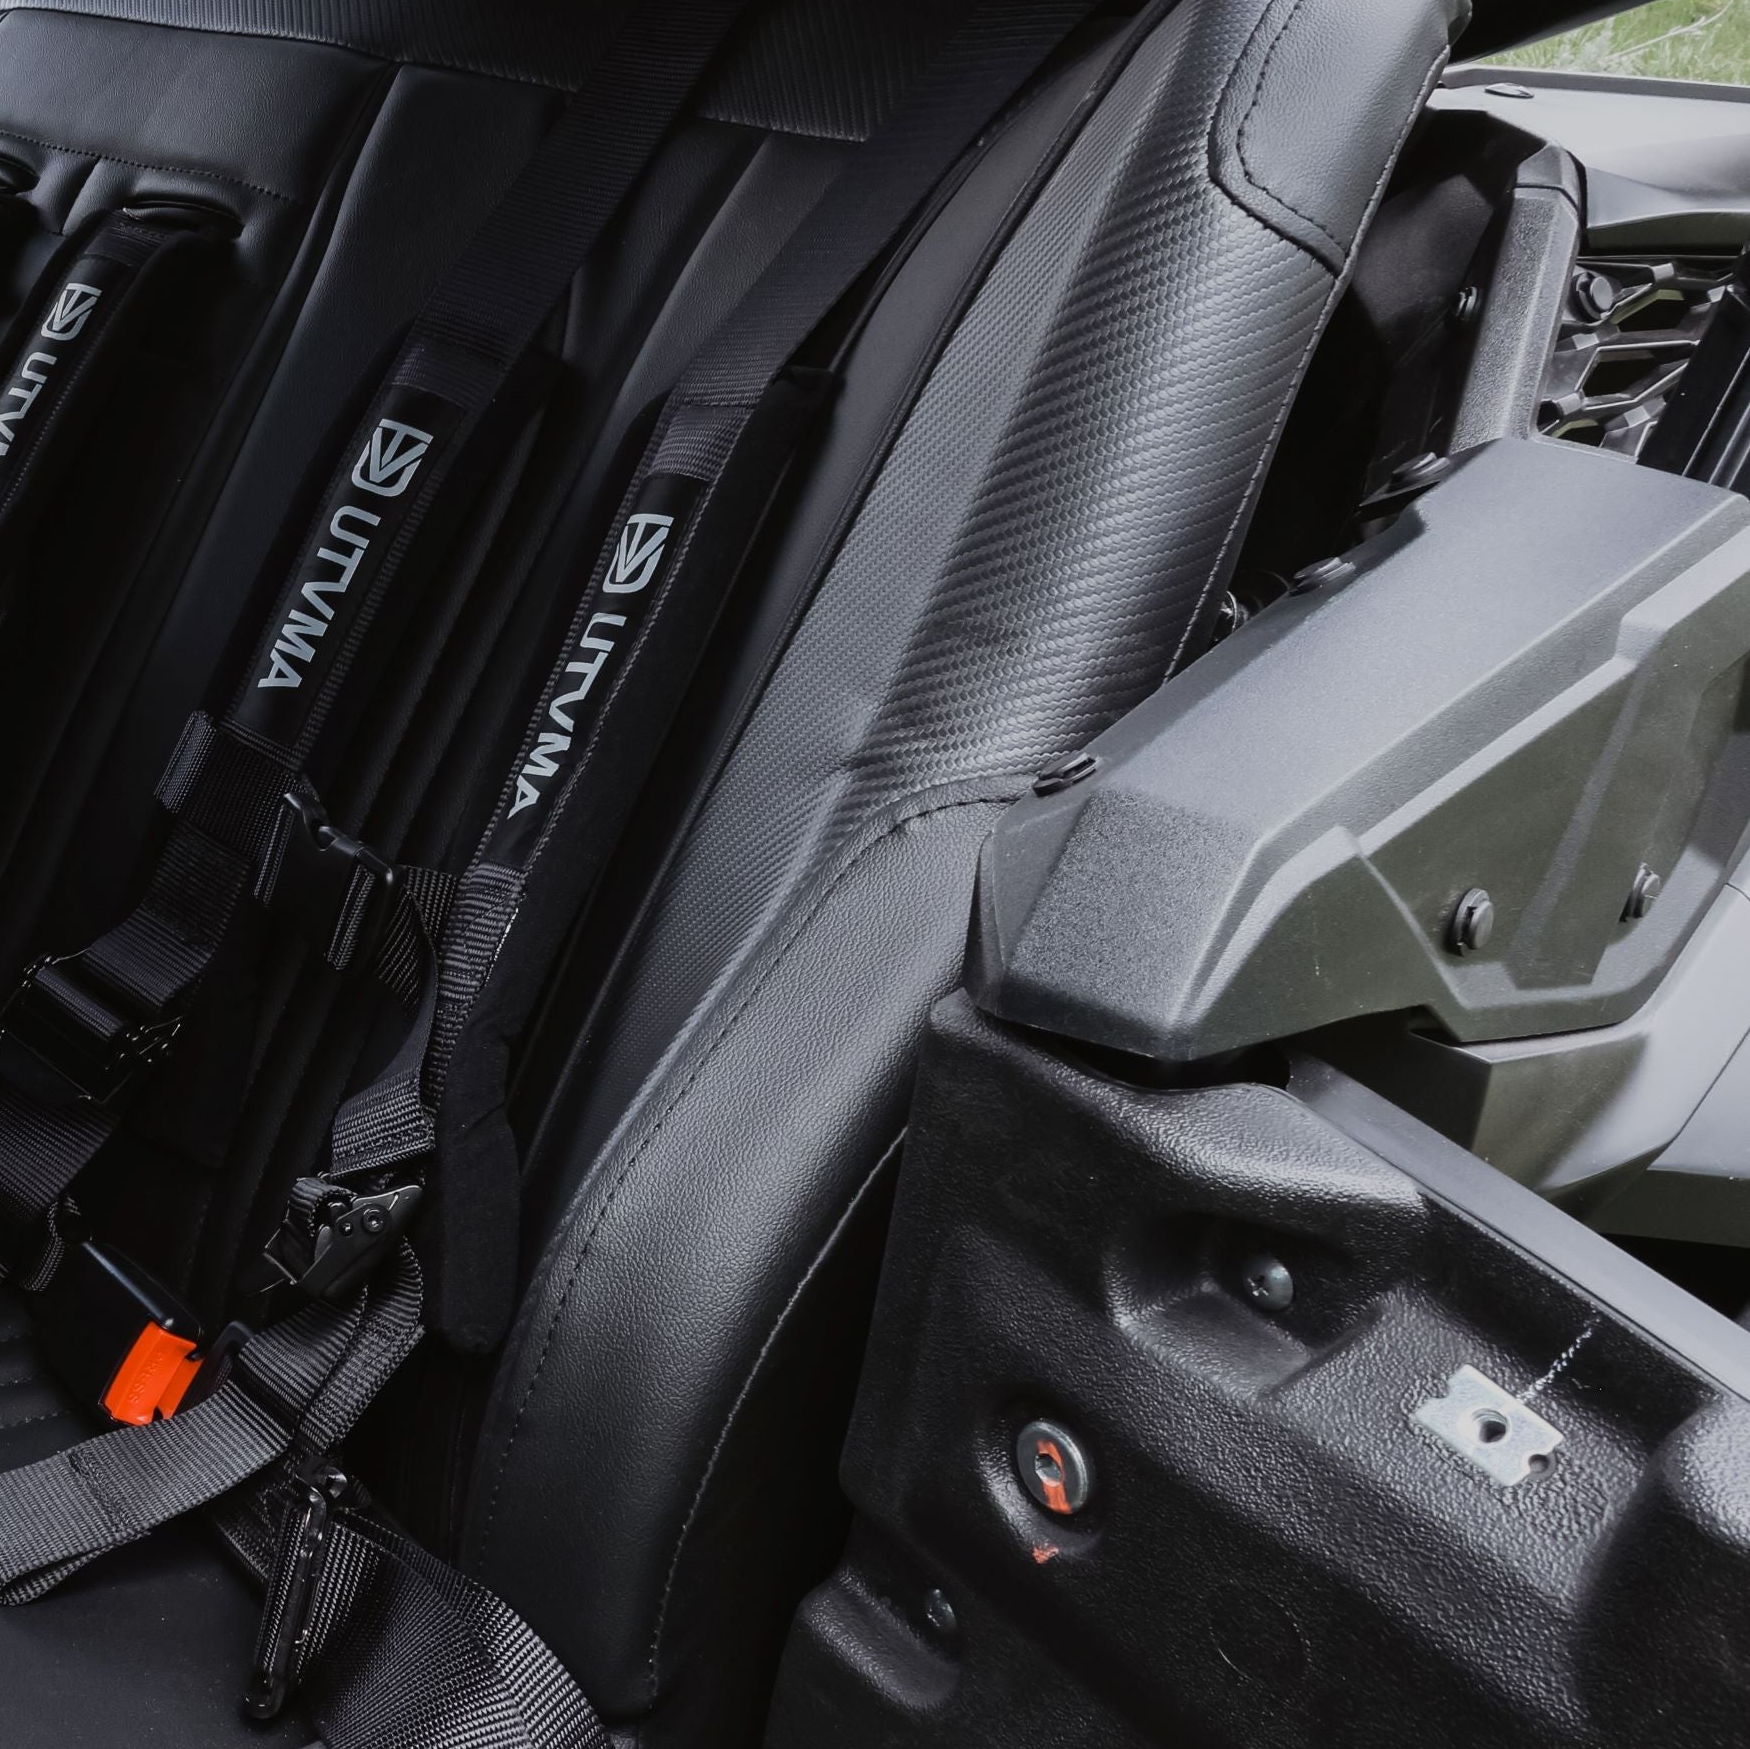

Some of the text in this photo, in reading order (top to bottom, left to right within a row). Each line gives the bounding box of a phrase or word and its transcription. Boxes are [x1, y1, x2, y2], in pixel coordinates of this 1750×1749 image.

[257, 505, 382, 689] UTVMA
[506, 612, 627, 820] UTVMA
[128, 1352, 164, 1404] PRESS
